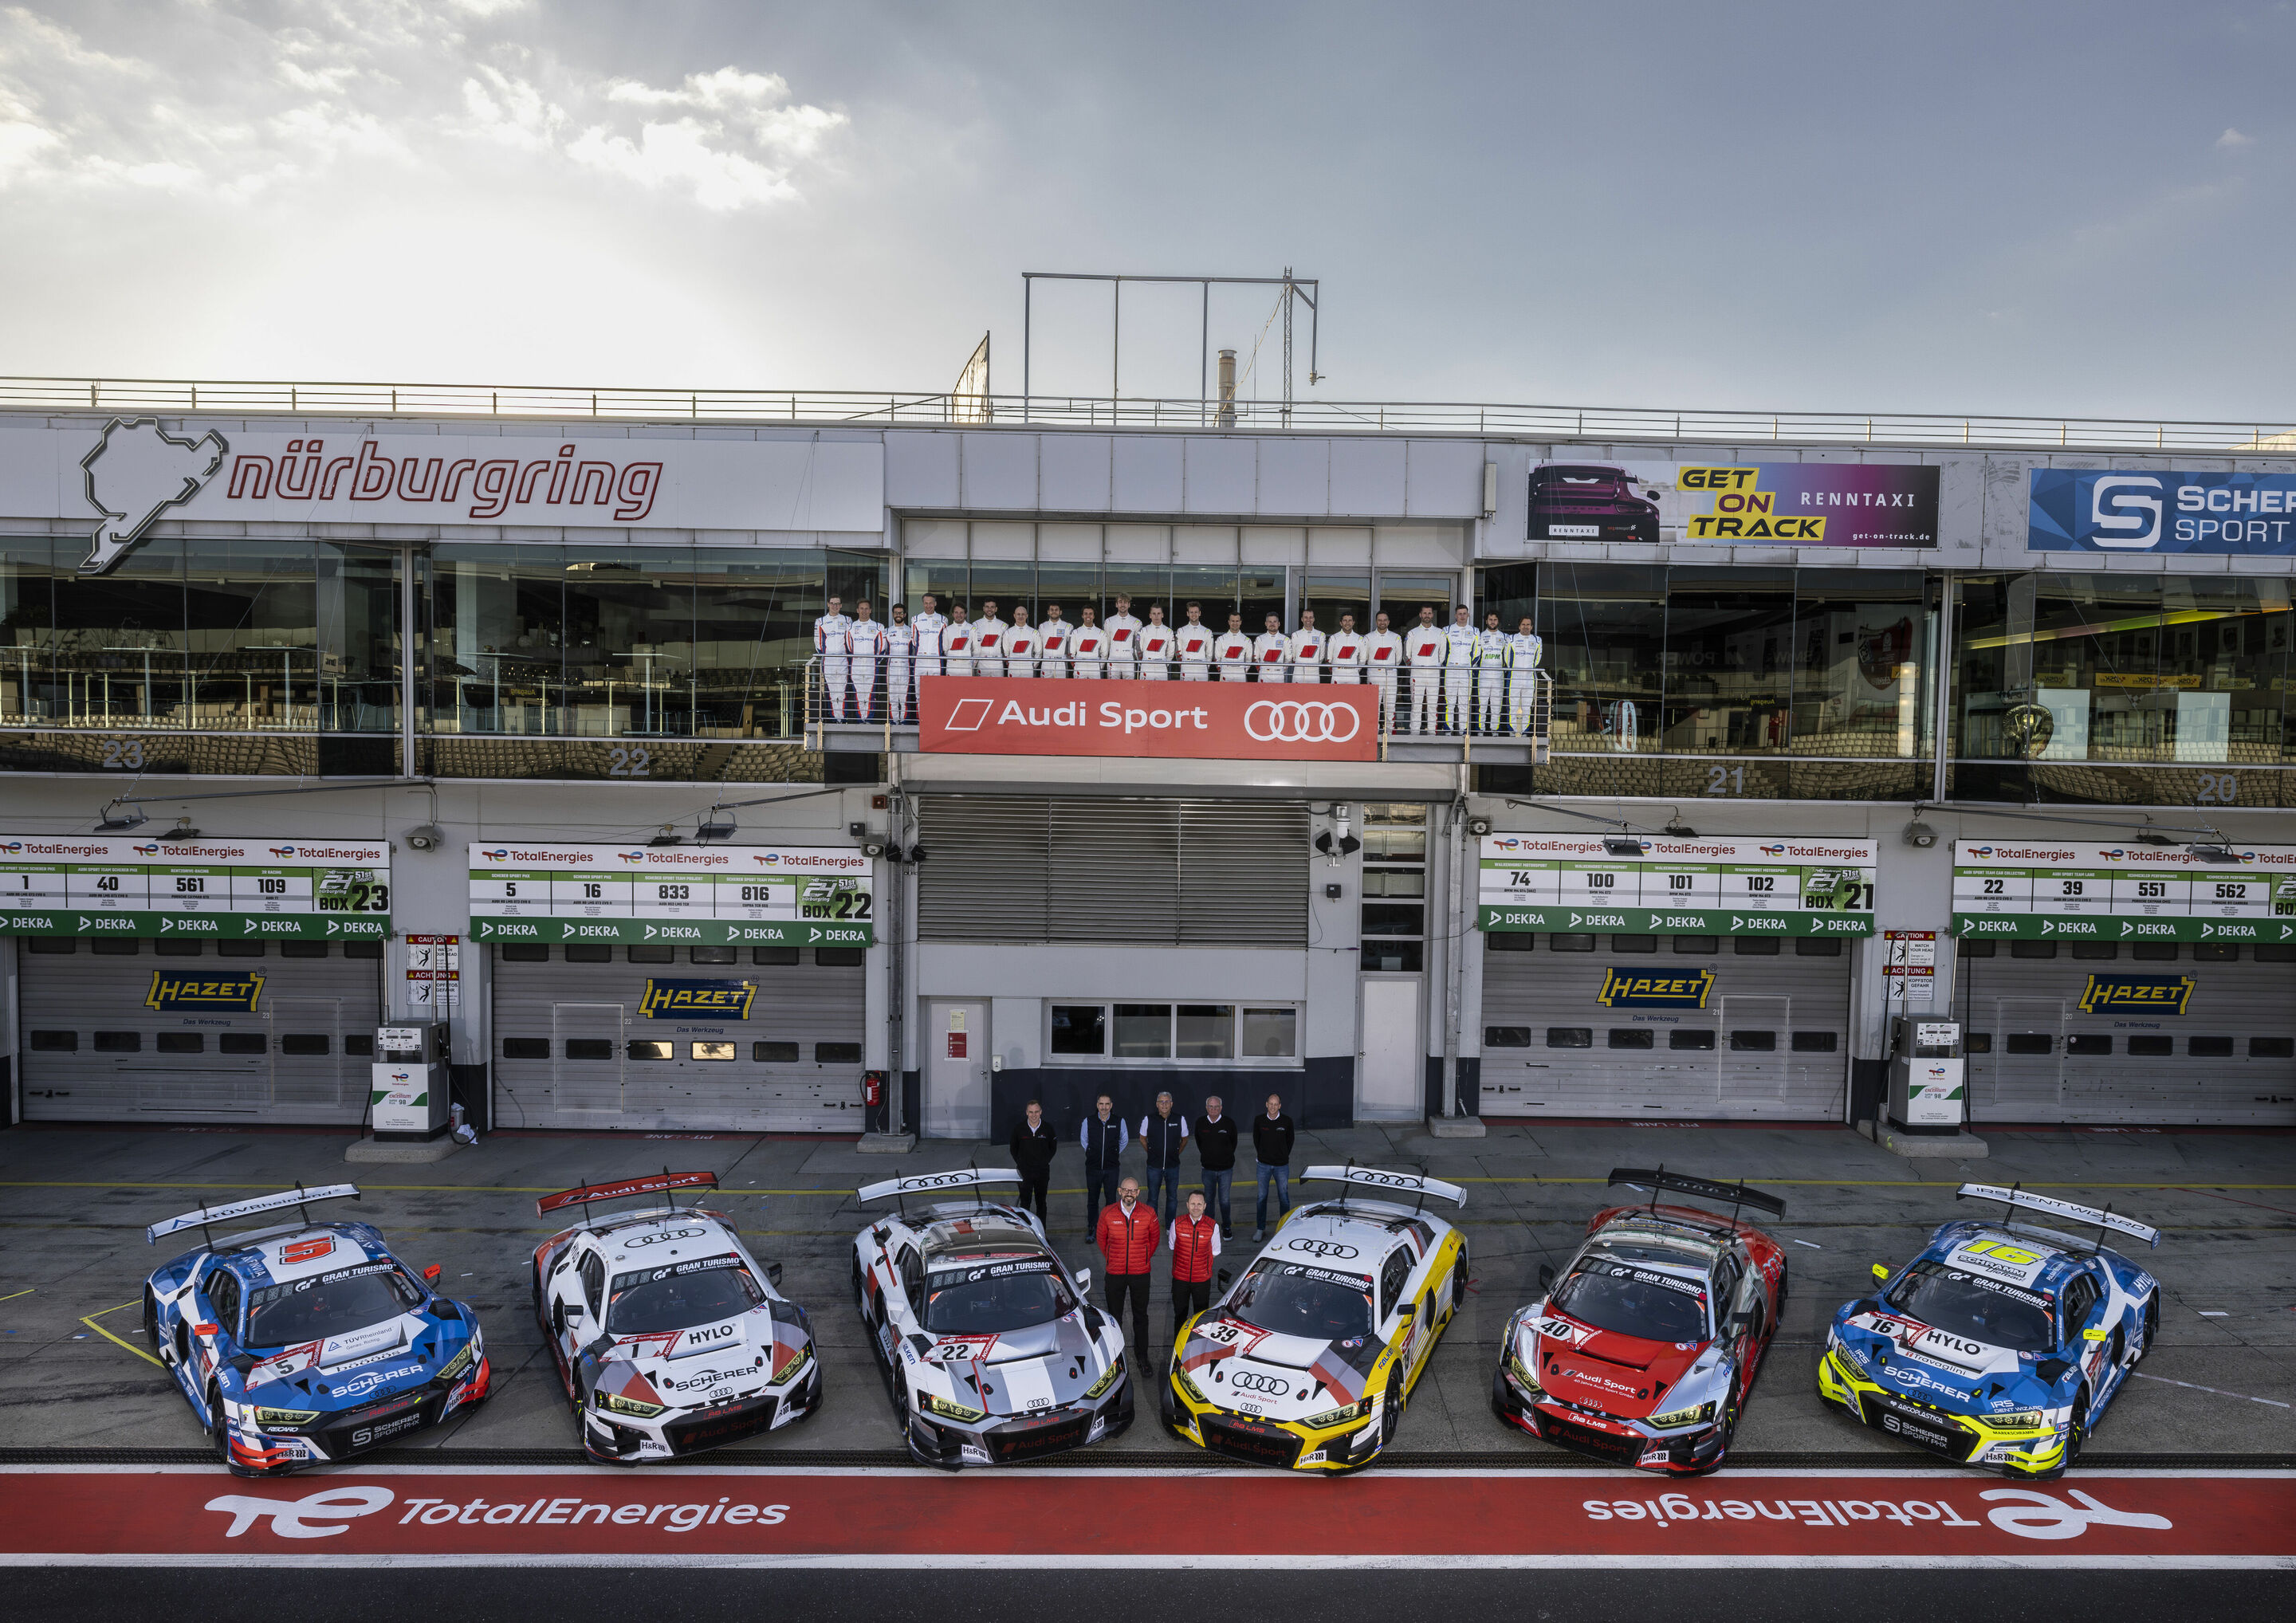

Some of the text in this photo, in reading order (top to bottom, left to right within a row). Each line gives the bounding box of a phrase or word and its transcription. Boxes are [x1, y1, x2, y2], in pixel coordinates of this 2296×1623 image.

[226, 438, 663, 521] nürburgring
[1682, 470, 1756, 489] GET
[1718, 494, 1771, 513] ON
[1800, 492, 1915, 508] RENNTAXI
[1693, 517, 1823, 538] TRACK
[2175, 519, 2290, 543] SPORT
[1853, 532, 1931, 541] get-on-track.de
[997, 700, 1209, 734] Audi Sport
[103, 740, 145, 769] 23
[610, 748, 651, 777] 22
[1708, 765, 1744, 794] 21
[2196, 774, 2237, 802] 20
[25, 843, 108, 856] TotalEnergies
[161, 845, 244, 859] TotalEnergies
[297, 847, 380, 861] TotalEnergies
[1521, 840, 1602, 854] TotalEnergies
[1654, 843, 1736, 856] TotalEnergies
[1787, 846, 1868, 859] TotalEnergies
[1995, 848, 2075, 861] TotalEnergies
[510, 851, 593, 864] TotalEnergies
[646, 853, 729, 866] TotalEnergies
[781, 855, 864, 869] TotalEnergies
[22, 875, 29, 890] 1
[97, 877, 119, 890] 40
[176, 878, 204, 892] 561
[258, 878, 285, 893] 109
[1510, 871, 1531, 886] 74
[1586, 873, 1614, 888] 100
[1669, 875, 1693, 890] 101
[1747, 876, 1774, 891] 102
[506, 882, 516, 897] 5
[584, 883, 601, 898] 16
[659, 885, 690, 899] 833
[741, 886, 769, 901] 816
[1983, 879, 2003, 894] 22
[2062, 881, 2083, 895] 39
[2138, 882, 2165, 897] 551
[2215, 884, 2246, 898] 562
[319, 885, 389, 911] BOX 23
[1805, 883, 1874, 910] BOX 21
[802, 892, 872, 919] BOX 22
[12, 918, 53, 929] DEKRA
[96, 918, 136, 929] DEKRA
[178, 920, 218, 931] DEKRA
[261, 921, 302, 932] DEKRA
[1506, 913, 1545, 925] DEKRA
[1586, 914, 1626, 926] DEKRA
[1666, 916, 1706, 928] DEKRA
[1748, 918, 1787, 929] DEKRA
[1828, 920, 1867, 931] DEKRA
[1979, 921, 2018, 932] DEKRA
[344, 922, 384, 933] DEKRA
[497, 925, 537, 936] DEKRA
[580, 925, 619, 937] DEKRA
[661, 926, 702, 937] DEKRA
[744, 929, 784, 939] DEKRA
[826, 929, 866, 941] DEKRA
[2058, 922, 2097, 933] DEKRA
[2137, 924, 2176, 935] DEKRA
[2218, 925, 2257, 937] DEKRA
[158, 980, 253, 1001] HAZET
[1610, 977, 1703, 997] HAZET
[2090, 984, 2183, 1004] HAZET
[651, 988, 745, 1009] HAZET
[589, 1176, 700, 1198] Audi Sport
[2012, 1193, 2145, 1232] DENT WIZARD
[279, 1235, 336, 1265] 5
[1958, 1238, 2047, 1266] 16
[676, 1256, 740, 1272] GRAN TURISMO
[990, 1262, 1050, 1275] GRAN TURISMO
[1956, 1254, 2027, 1278] SCHRAMM
[321, 1263, 394, 1283] GRAN TURISMO
[1305, 1267, 1370, 1289] GRAN TURISMO
[1634, 1271, 1703, 1295] GRAN TURISMO
[2134, 1272, 2153, 1293] HYLO
[1972, 1277, 2049, 1307] GRAN TURISMO
[1539, 1321, 1571, 1338] 40
[1869, 1318, 1897, 1334] 16
[344, 1326, 395, 1345] TÜVRheinland
[688, 1325, 733, 1346] HYLO
[1209, 1325, 1239, 1343] 39
[631, 1343, 639, 1358] 1
[1926, 1330, 1982, 1356] HYLO
[942, 1344, 969, 1361] 22
[274, 1359, 295, 1375] 5
[1911, 1353, 1968, 1377] Travaglini
[332, 1364, 424, 1398] SCHERER
[676, 1366, 758, 1393] SCHERER
[1575, 1372, 1637, 1394] Audi Sport
[1883, 1365, 1971, 1404] SCHERER
[1257, 1396, 1278, 1405] Sport
[1618, 1390, 1635, 1400] GmbH
[1991, 1400, 2014, 1409] IRS
[1897, 1402, 1944, 1425] ARCOPLASTICA
[374, 1413, 420, 1433] SCHERER
[374, 1419, 419, 1440] SPORT PHX
[1246, 1425, 1266, 1434] LMS
[1586, 1418, 1607, 1429] LMS
[1901, 1428, 1948, 1449] SPORT PHX
[1902, 1421, 1948, 1443] SCHERER
[642, 1441, 658, 1451] H&R
[962, 1446, 979, 1456] H&R
[1642, 1453, 1657, 1464] H&R
[1986, 1452, 2004, 1461] H&R
[398, 1497, 791, 1533] TotalEnergies
[1582, 1492, 1982, 1527] TotalEnergies
